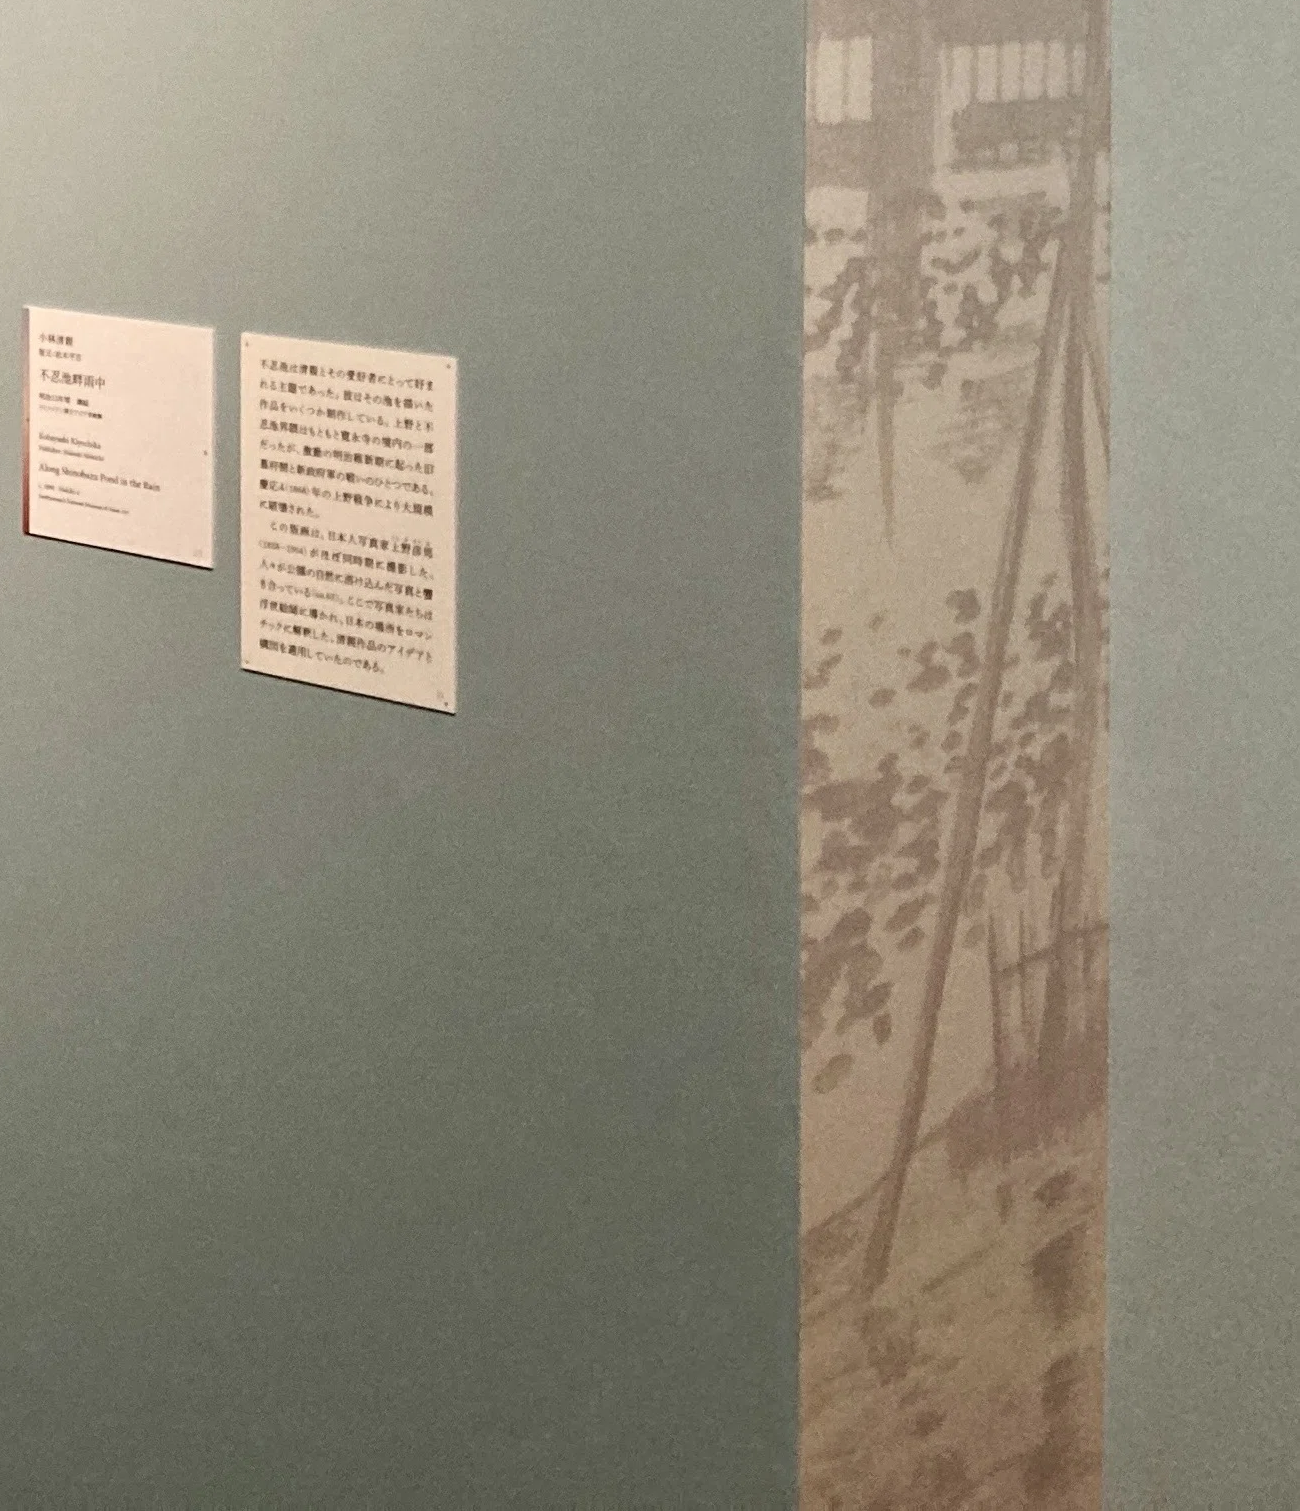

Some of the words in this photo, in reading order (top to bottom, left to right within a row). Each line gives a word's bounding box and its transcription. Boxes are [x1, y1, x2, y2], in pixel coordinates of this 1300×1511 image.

[39, 462, 60, 476] Along
[100, 472, 119, 484] Pond
[129, 477, 142, 488] the
